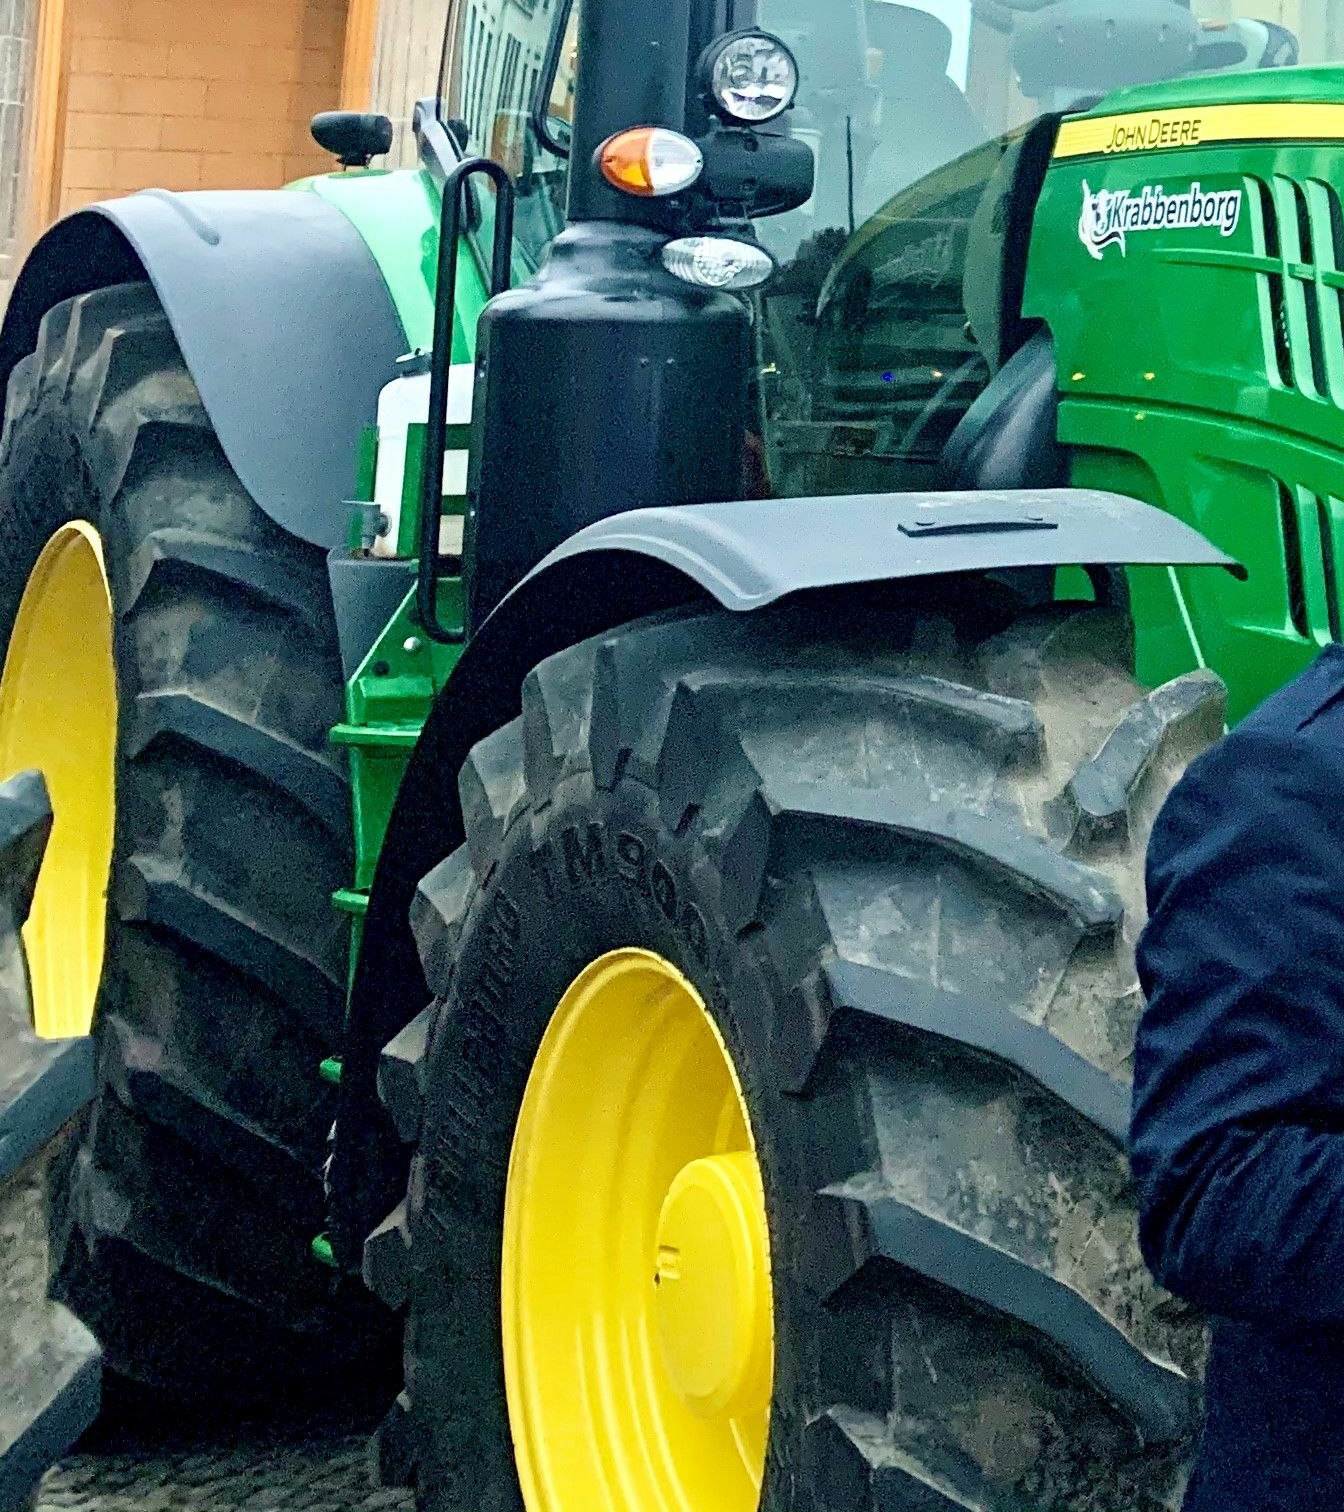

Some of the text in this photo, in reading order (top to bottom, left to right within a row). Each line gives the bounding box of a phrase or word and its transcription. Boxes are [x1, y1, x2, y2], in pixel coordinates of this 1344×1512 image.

[1106, 119, 1201, 149] JOHN DEERE
[1112, 188, 1238, 232] Krabbenborg
